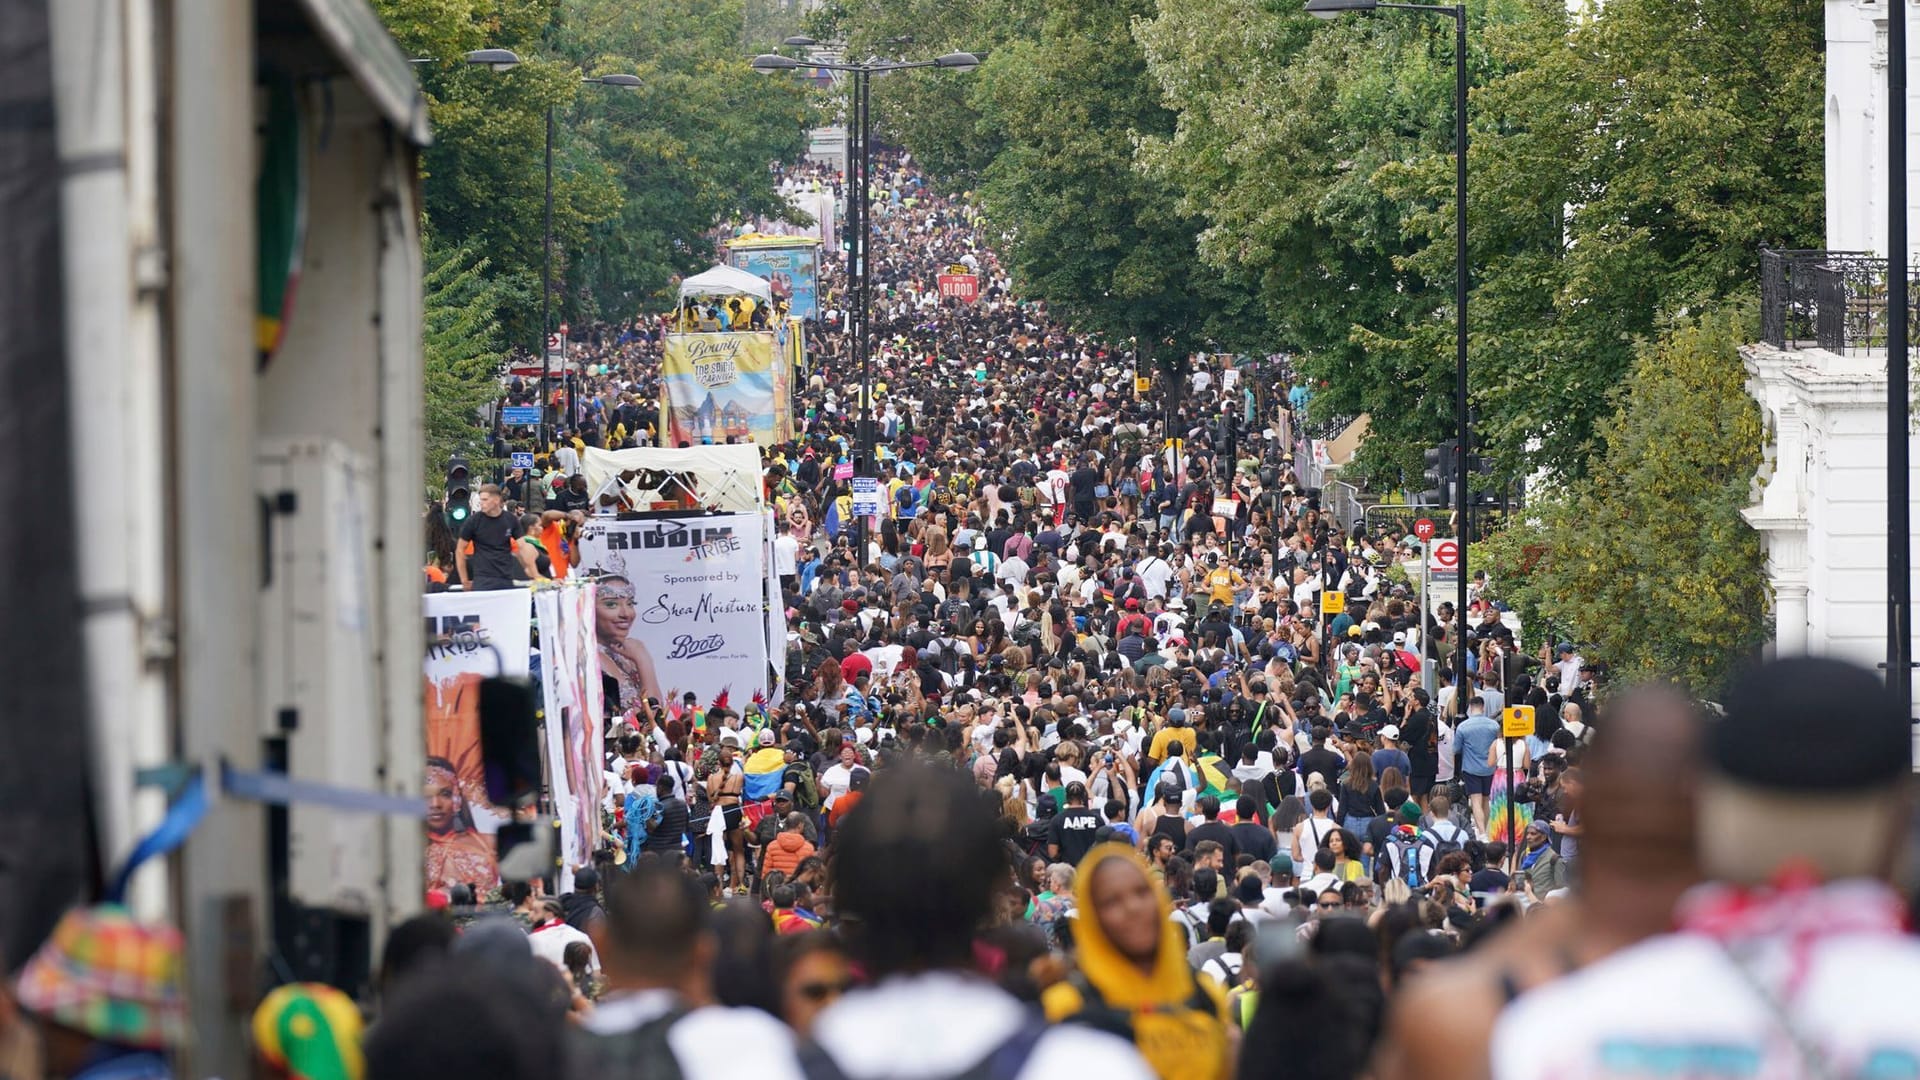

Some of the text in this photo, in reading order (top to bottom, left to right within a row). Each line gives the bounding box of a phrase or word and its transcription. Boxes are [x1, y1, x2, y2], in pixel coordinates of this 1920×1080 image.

[943, 283, 972, 296] BLOOD
[687, 338, 741, 361] Bounty
[607, 527, 732, 550] RIDDIM
[1418, 524, 1431, 534] PF
[690, 536, 741, 560] TRIBE
[664, 571, 739, 585] Sponsored by
[426, 628, 490, 660] TRIBE
[666, 634, 725, 660] Boots
[1063, 816, 1097, 830] AAPE
